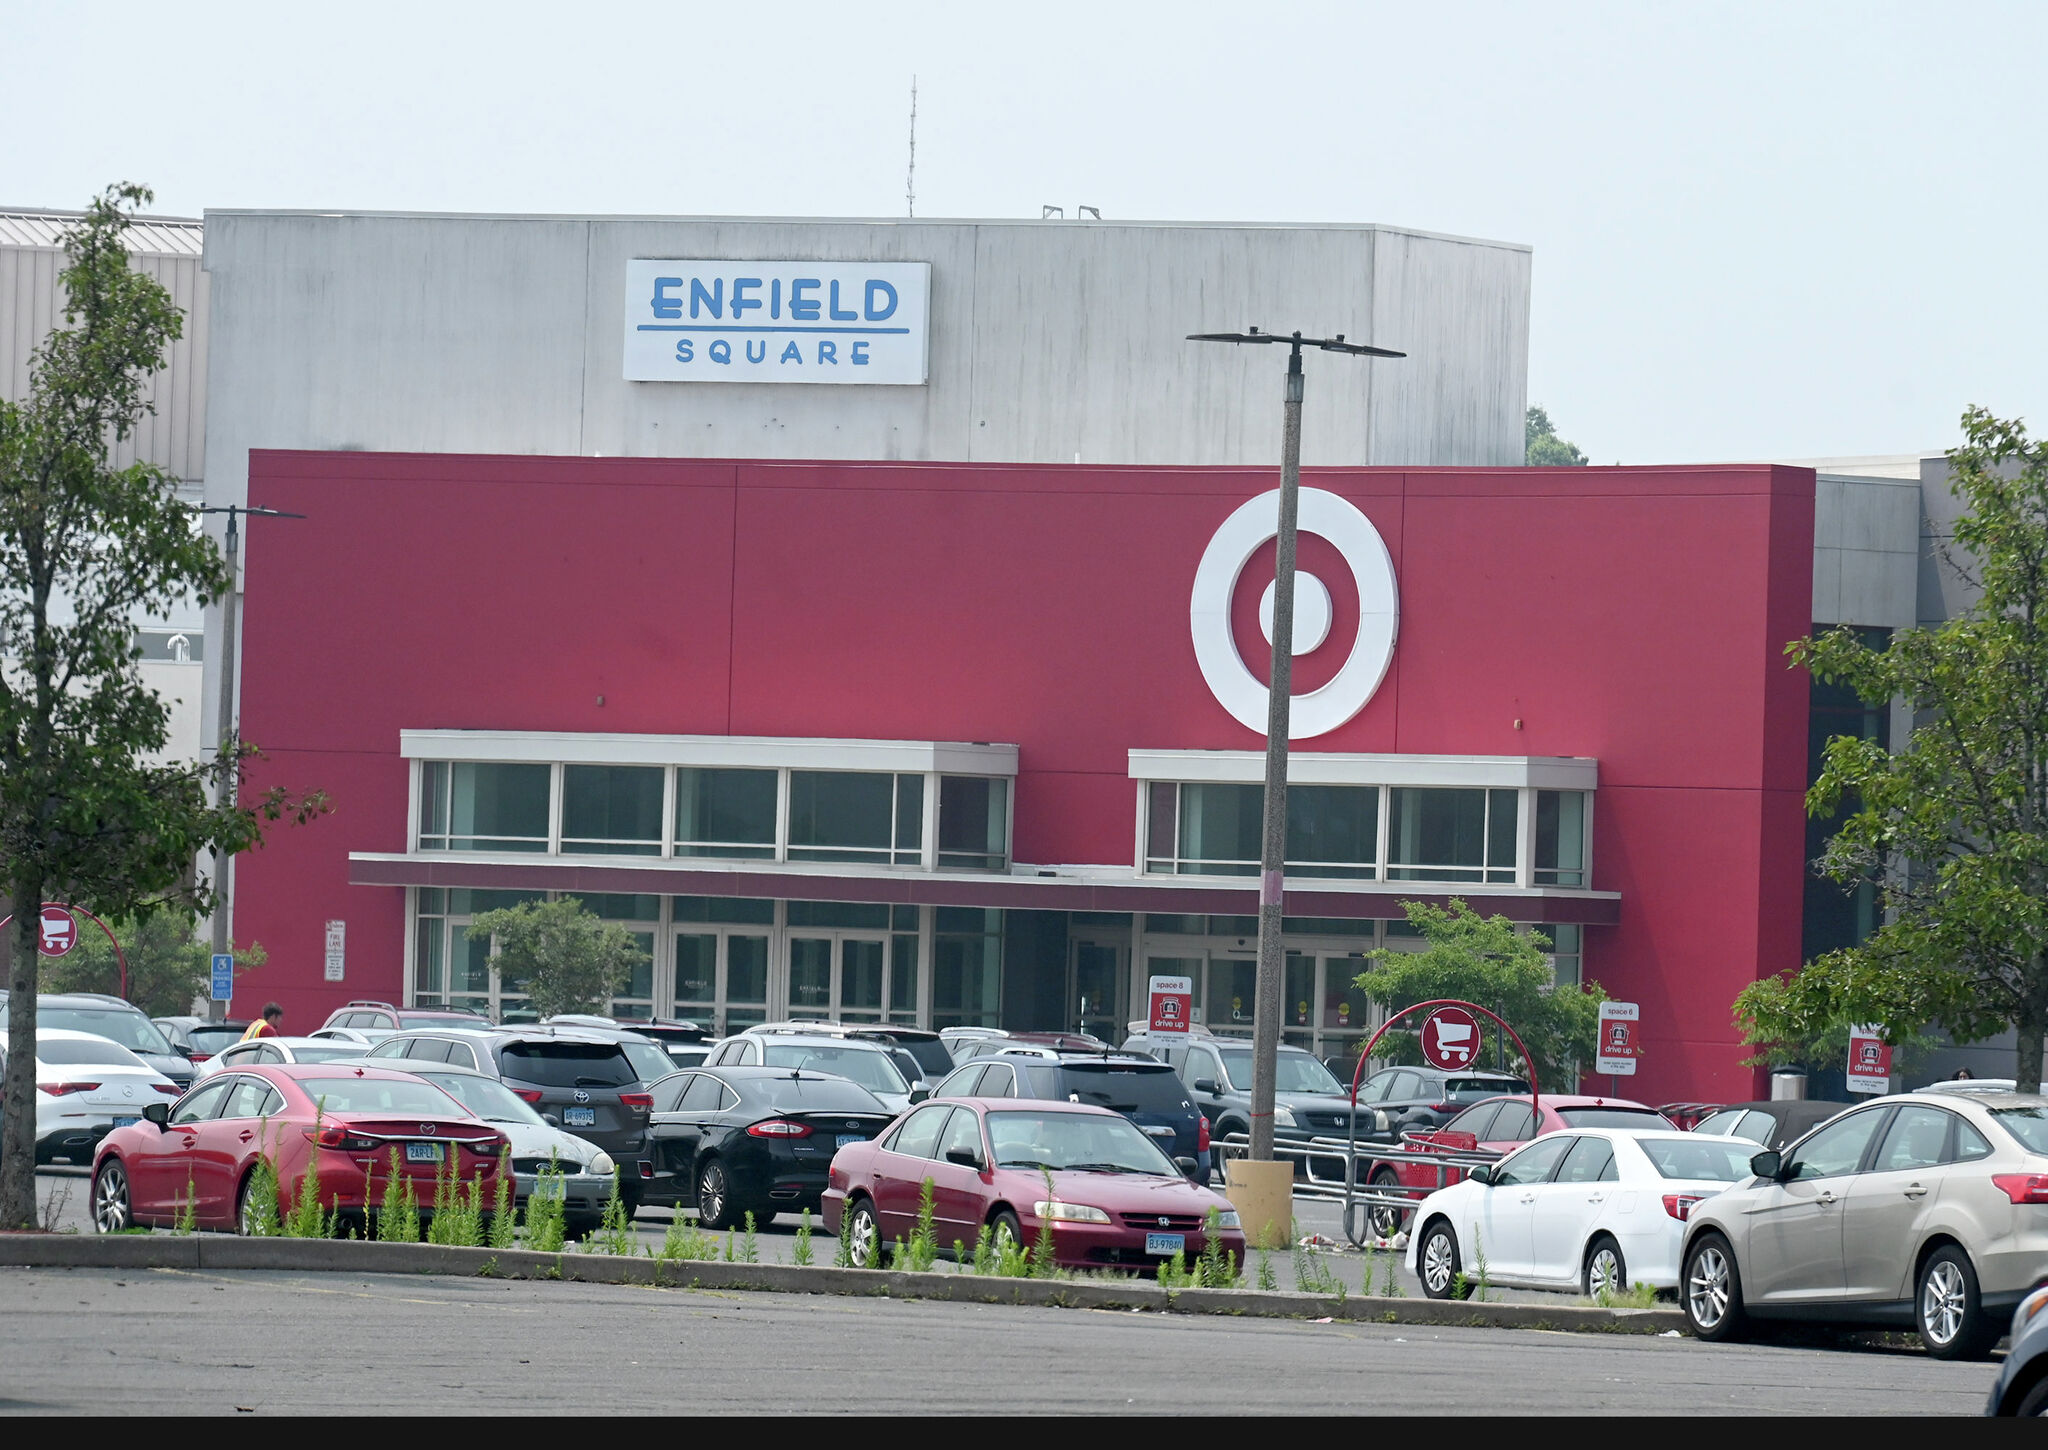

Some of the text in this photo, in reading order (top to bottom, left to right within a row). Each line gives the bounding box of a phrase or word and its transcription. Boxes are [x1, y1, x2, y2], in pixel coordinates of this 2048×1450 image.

[651, 277, 898, 321] ENFIELD
[676, 339, 870, 365] SQUARE
[1156, 982, 1178, 990] space
[1608, 1008, 1628, 1016] space
[1155, 1019, 1185, 1030] drive up
[1605, 1045, 1633, 1056] drive up
[1854, 1063, 1885, 1075] drive up
